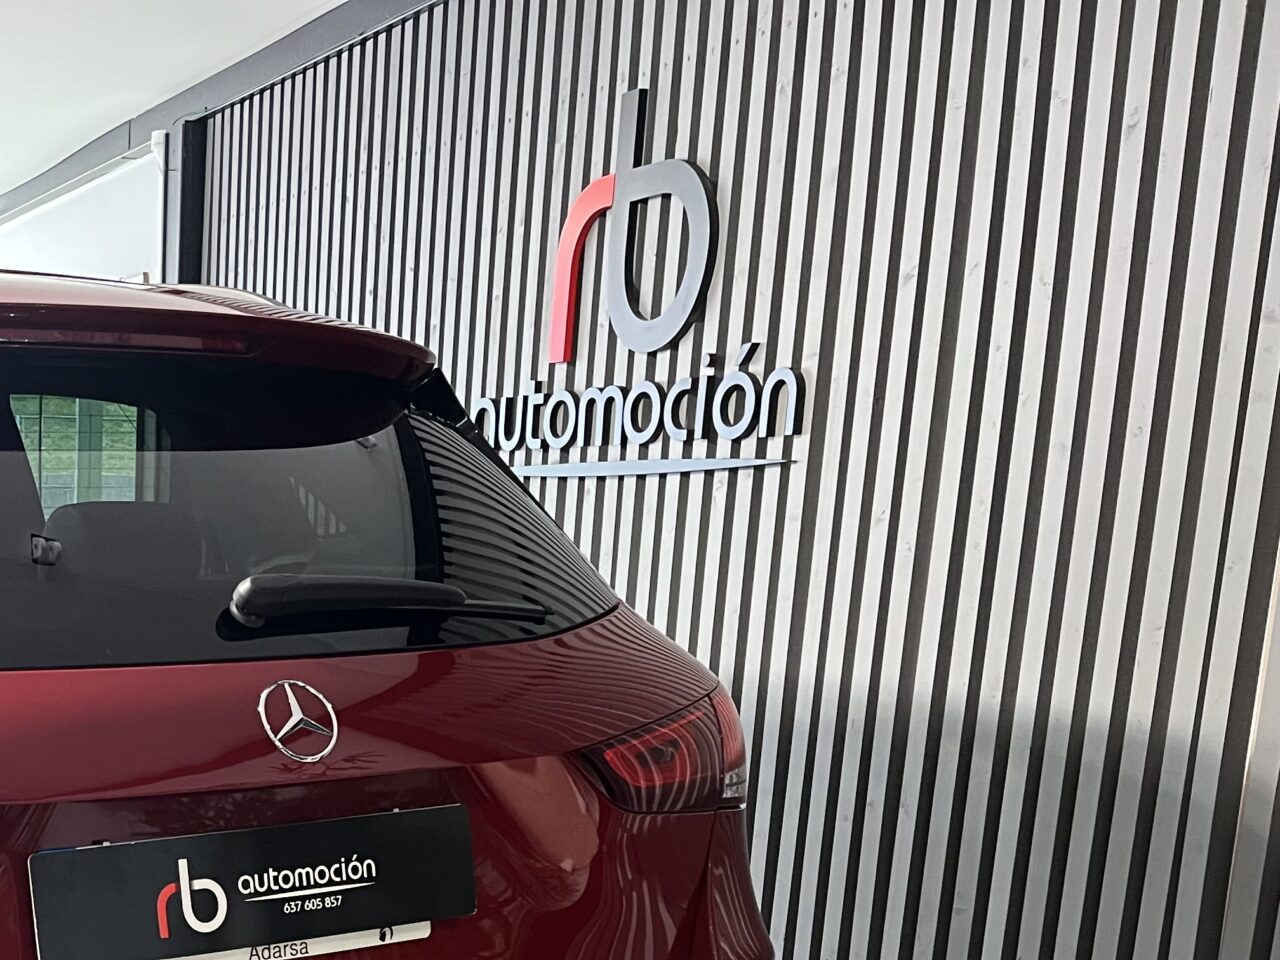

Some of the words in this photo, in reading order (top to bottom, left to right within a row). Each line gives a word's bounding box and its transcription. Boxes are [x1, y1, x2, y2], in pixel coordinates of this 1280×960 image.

[548, 88, 719, 363] rb
[156, 858, 228, 939] rb
[237, 854, 377, 894] automoción
[283, 900, 303, 914] 637
[304, 898, 323, 911] 605
[324, 896, 343, 908] 857
